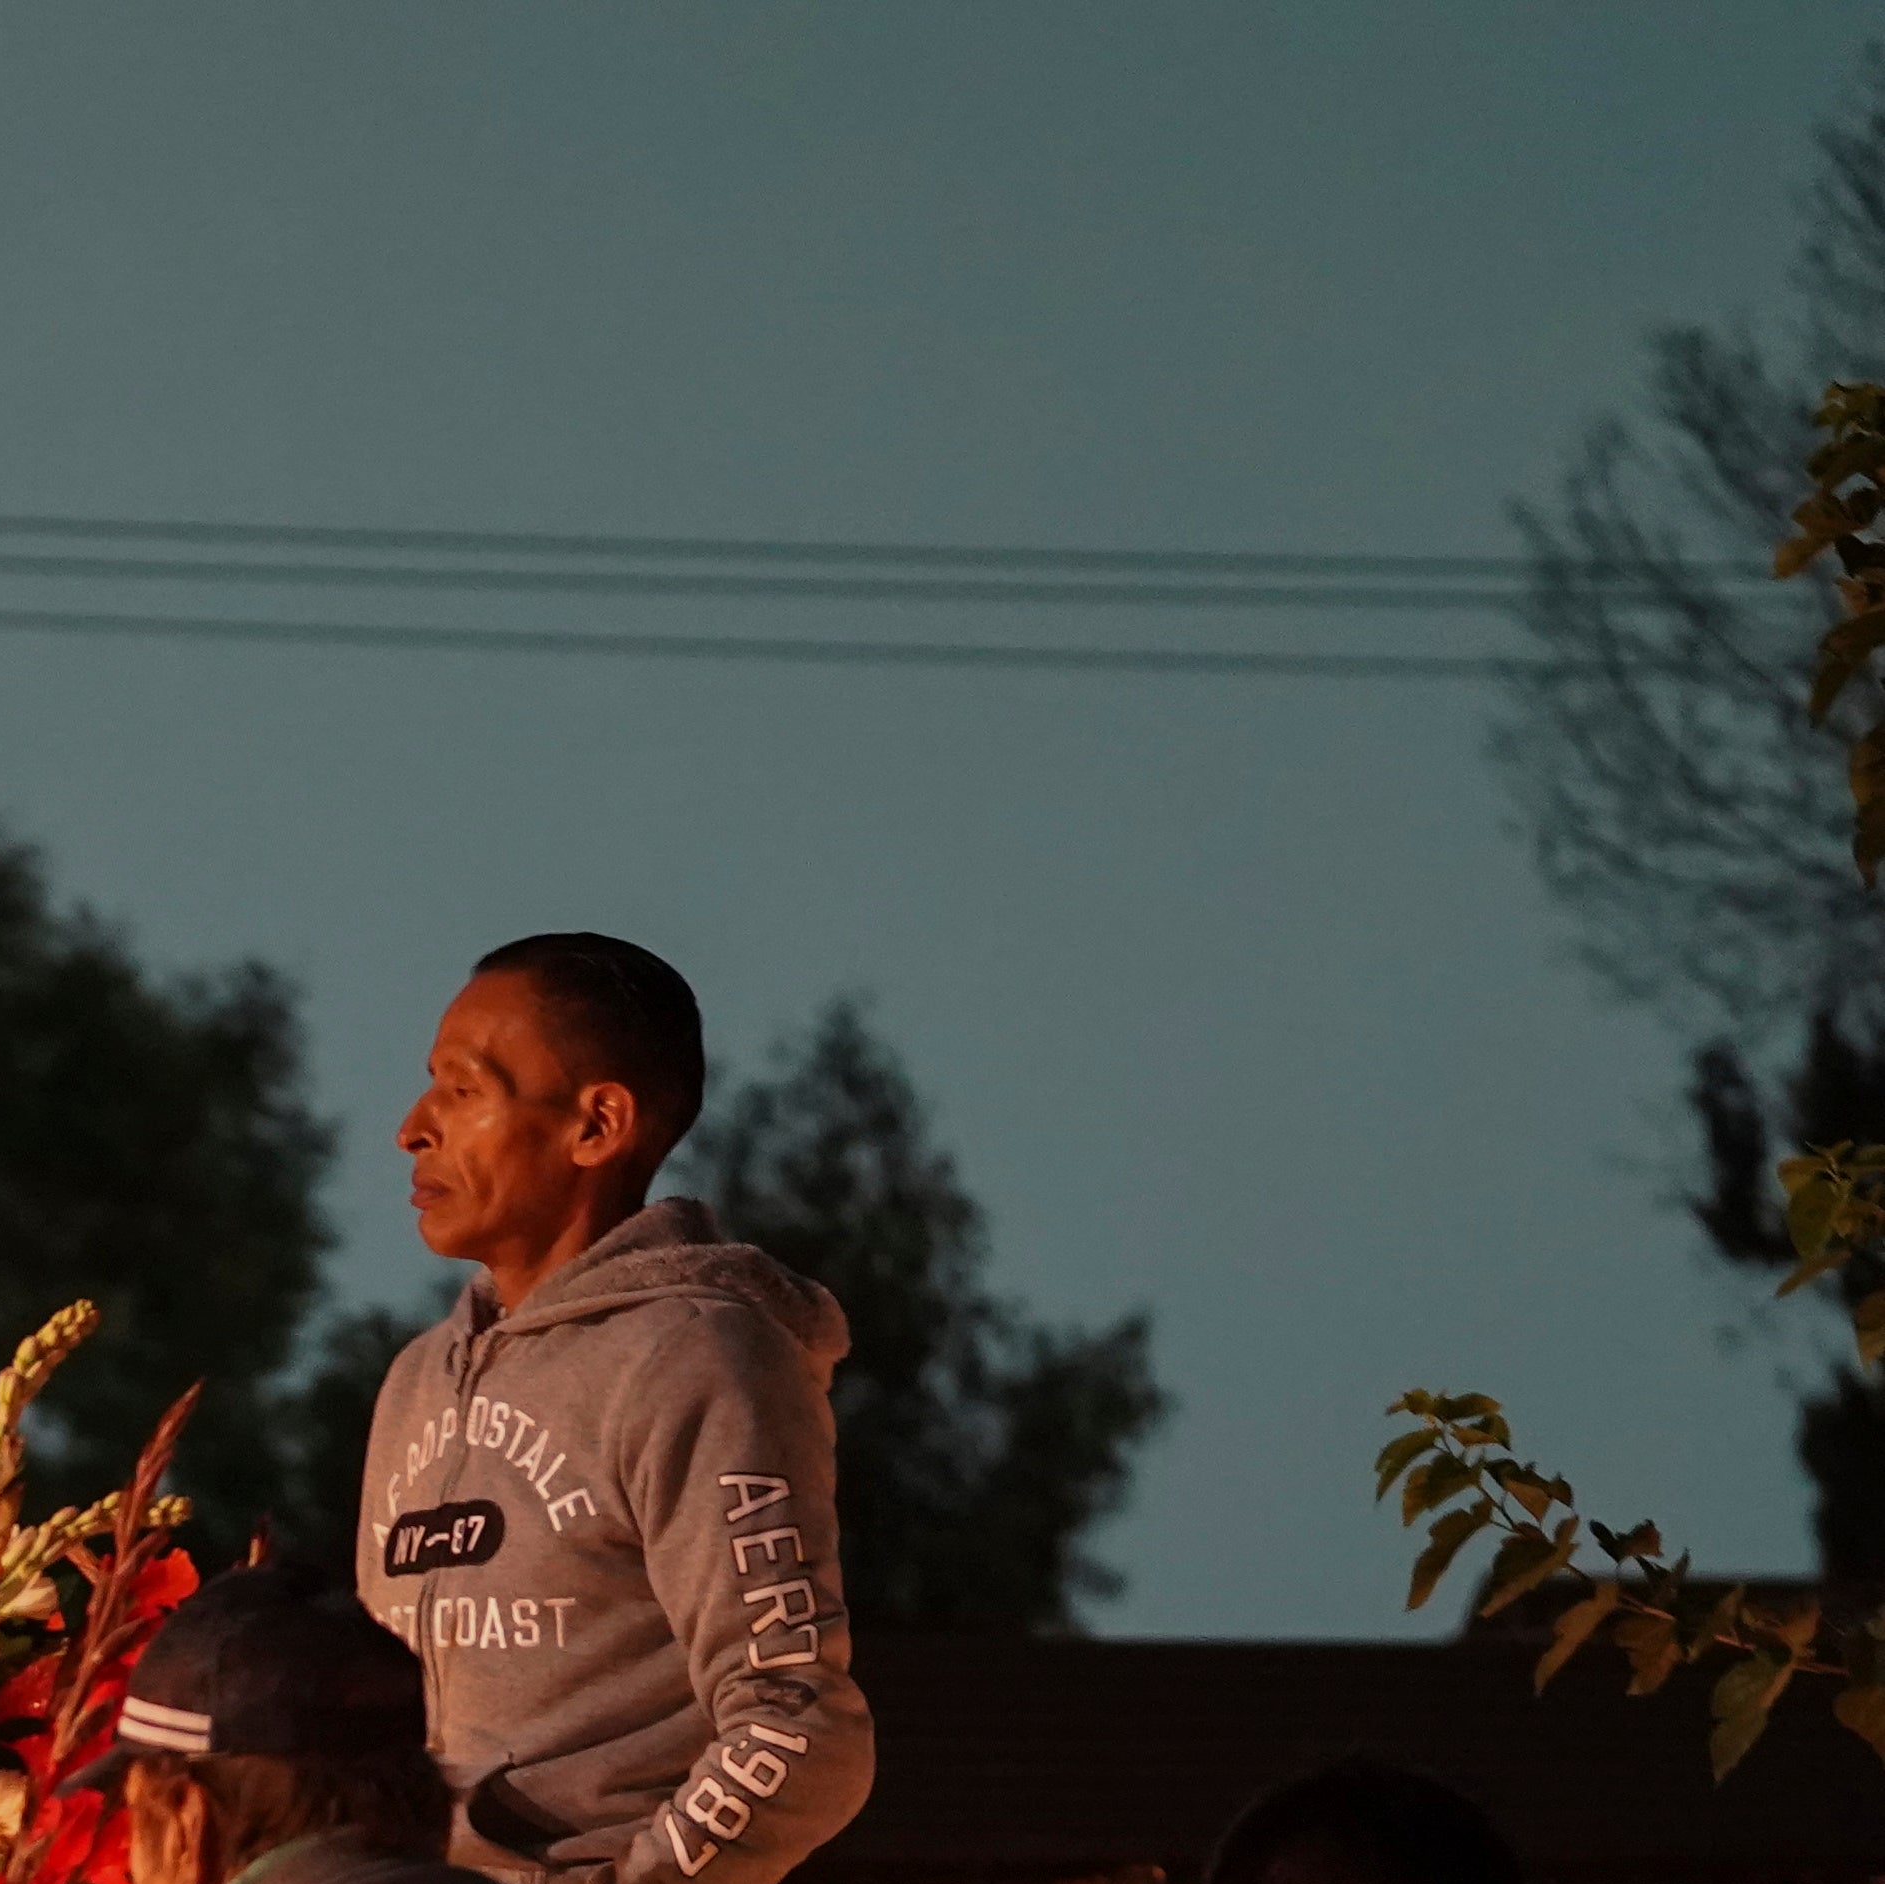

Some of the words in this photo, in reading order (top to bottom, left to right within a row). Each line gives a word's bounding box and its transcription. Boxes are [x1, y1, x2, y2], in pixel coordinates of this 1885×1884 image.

[392, 1514, 487, 1566] NY-87
[433, 1597, 576, 1649] COAST
[664, 1722, 808, 1877] 1987
